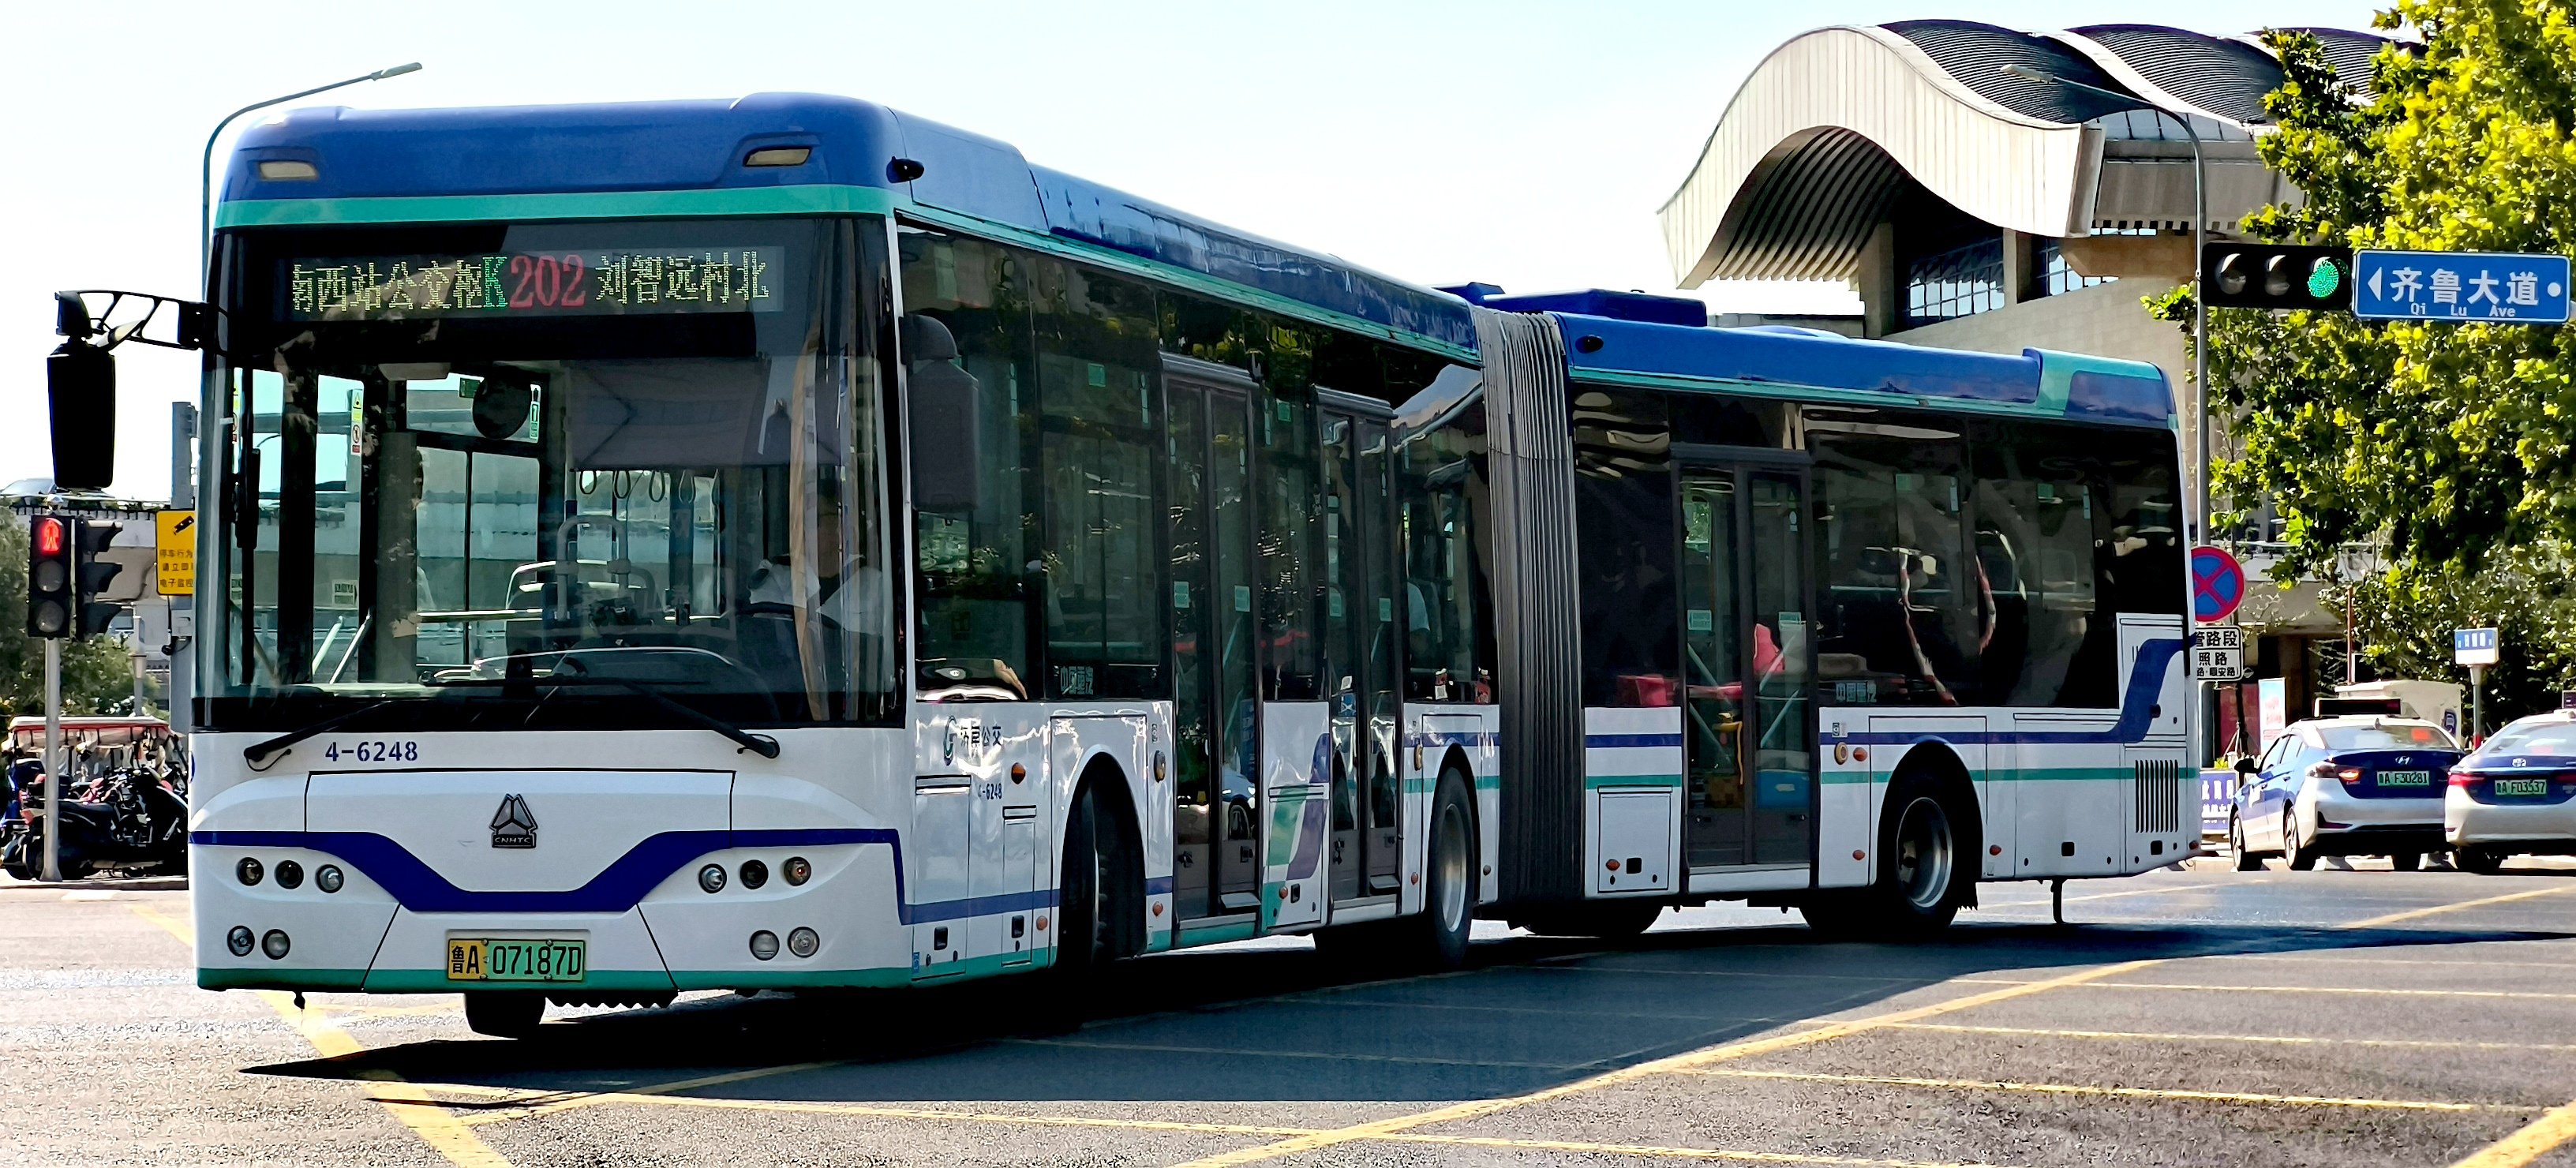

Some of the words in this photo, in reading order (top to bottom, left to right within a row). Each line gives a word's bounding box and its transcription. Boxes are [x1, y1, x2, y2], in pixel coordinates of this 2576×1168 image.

[482, 254, 586, 309] K202
[595, 251, 769, 304] 刘智远村北
[2389, 267, 2540, 306] 齐鲁大道
[2410, 302, 2426, 316] Qi
[2451, 303, 2468, 316] Lu
[2488, 304, 2516, 317] Ave
[324, 741, 418, 762] 4-6248
